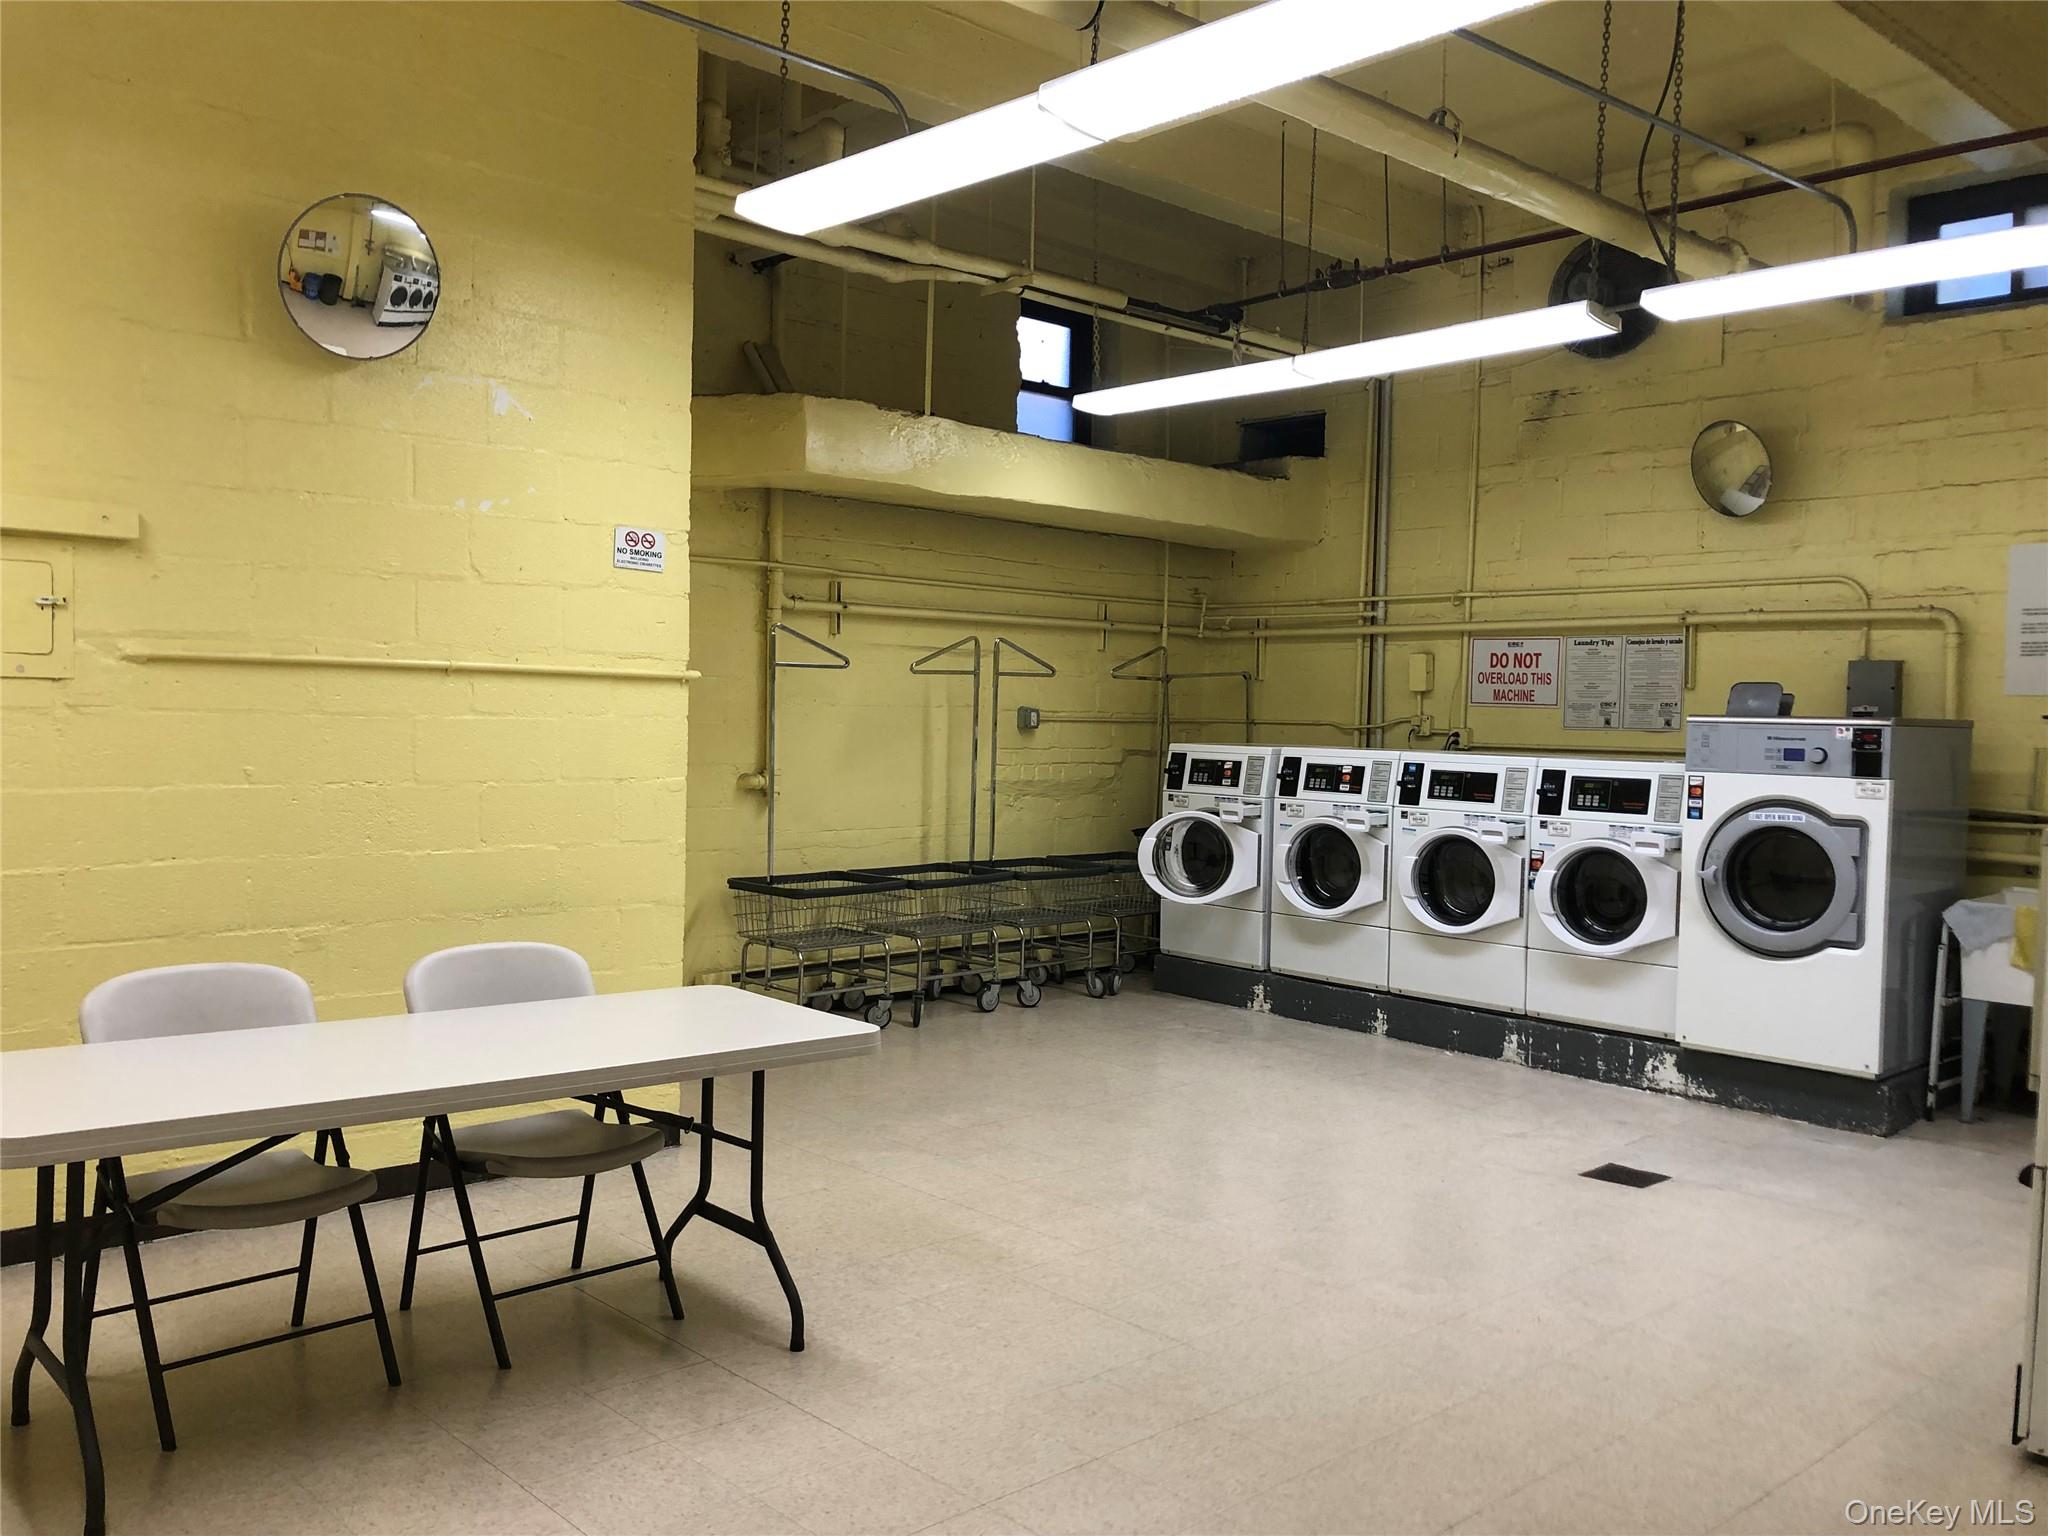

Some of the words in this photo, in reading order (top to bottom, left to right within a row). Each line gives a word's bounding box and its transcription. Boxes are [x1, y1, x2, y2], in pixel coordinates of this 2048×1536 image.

[629, 549, 662, 558] SMOKING
[1574, 639, 1599, 648] Laundry
[1601, 639, 1614, 647] Tips
[1490, 652, 1509, 668] DO
[1513, 652, 1542, 669] NOT
[1478, 672, 1528, 685] OVERLOAD
[1531, 672, 1552, 686] THIS
[1493, 689, 1535, 702] MACHINE
